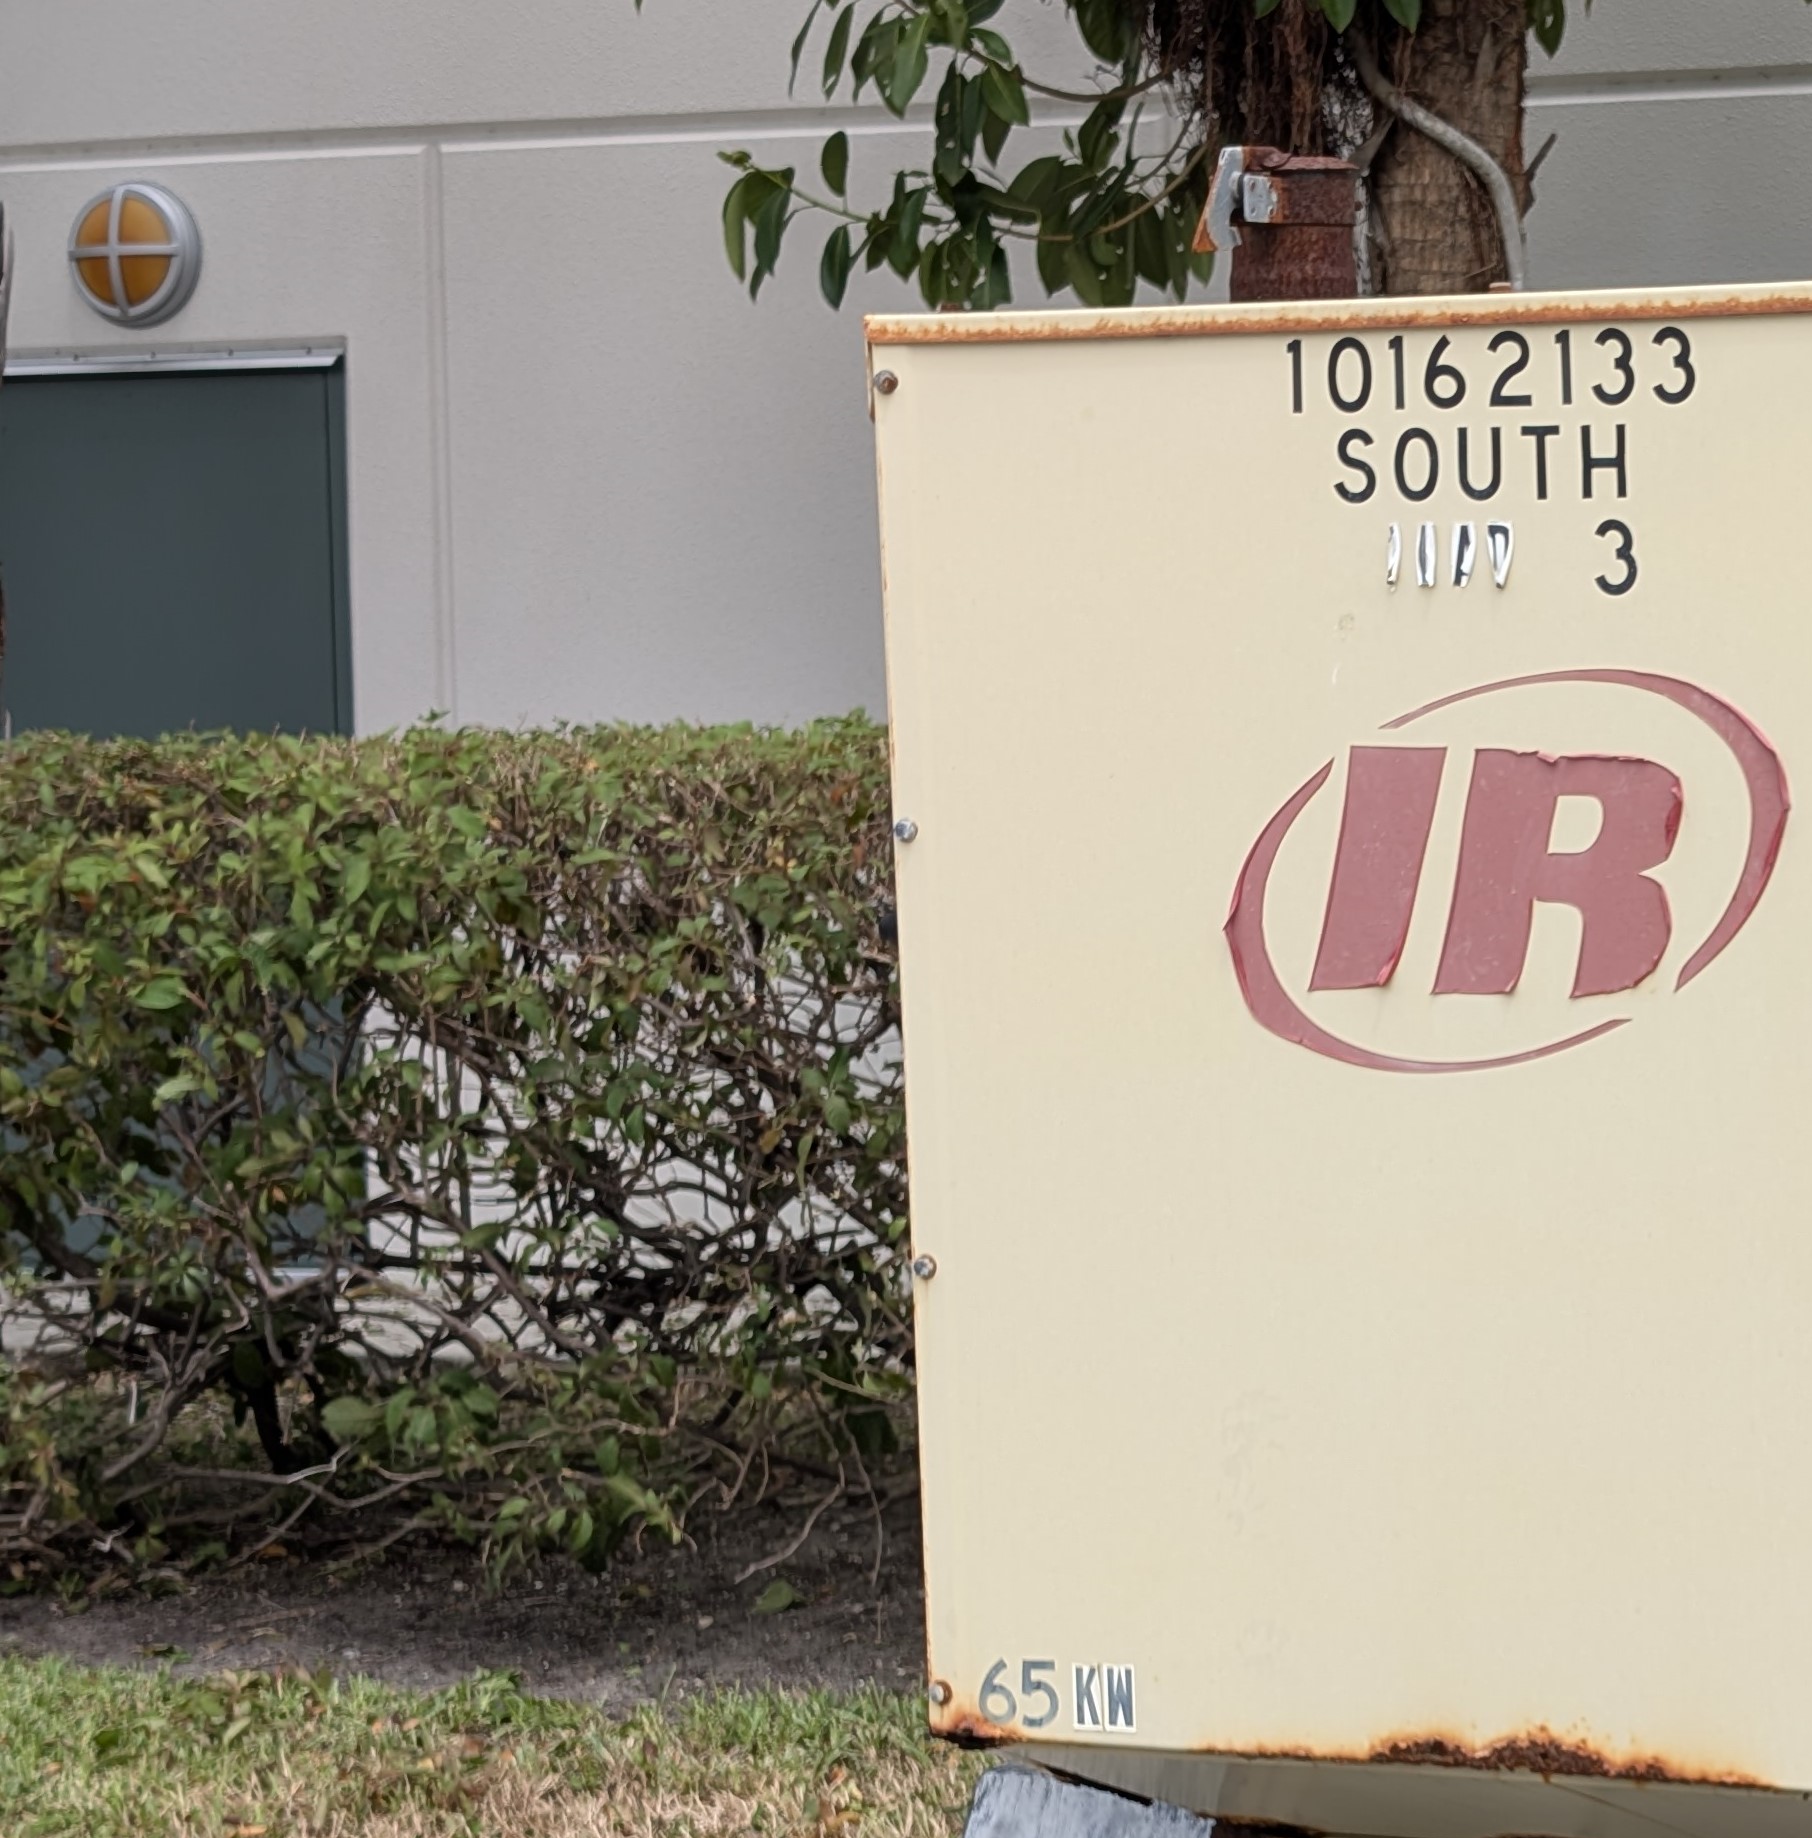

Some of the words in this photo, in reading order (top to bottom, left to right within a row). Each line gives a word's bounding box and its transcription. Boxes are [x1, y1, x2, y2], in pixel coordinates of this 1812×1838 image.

[1285, 326, 1696, 414] 10162133
[1333, 423, 1628, 503] SOUTH
[1594, 519, 1638, 596] 3
[1308, 745, 1684, 999] IR
[978, 1658, 1060, 1728] 65
[1074, 1664, 1134, 1729] KW
